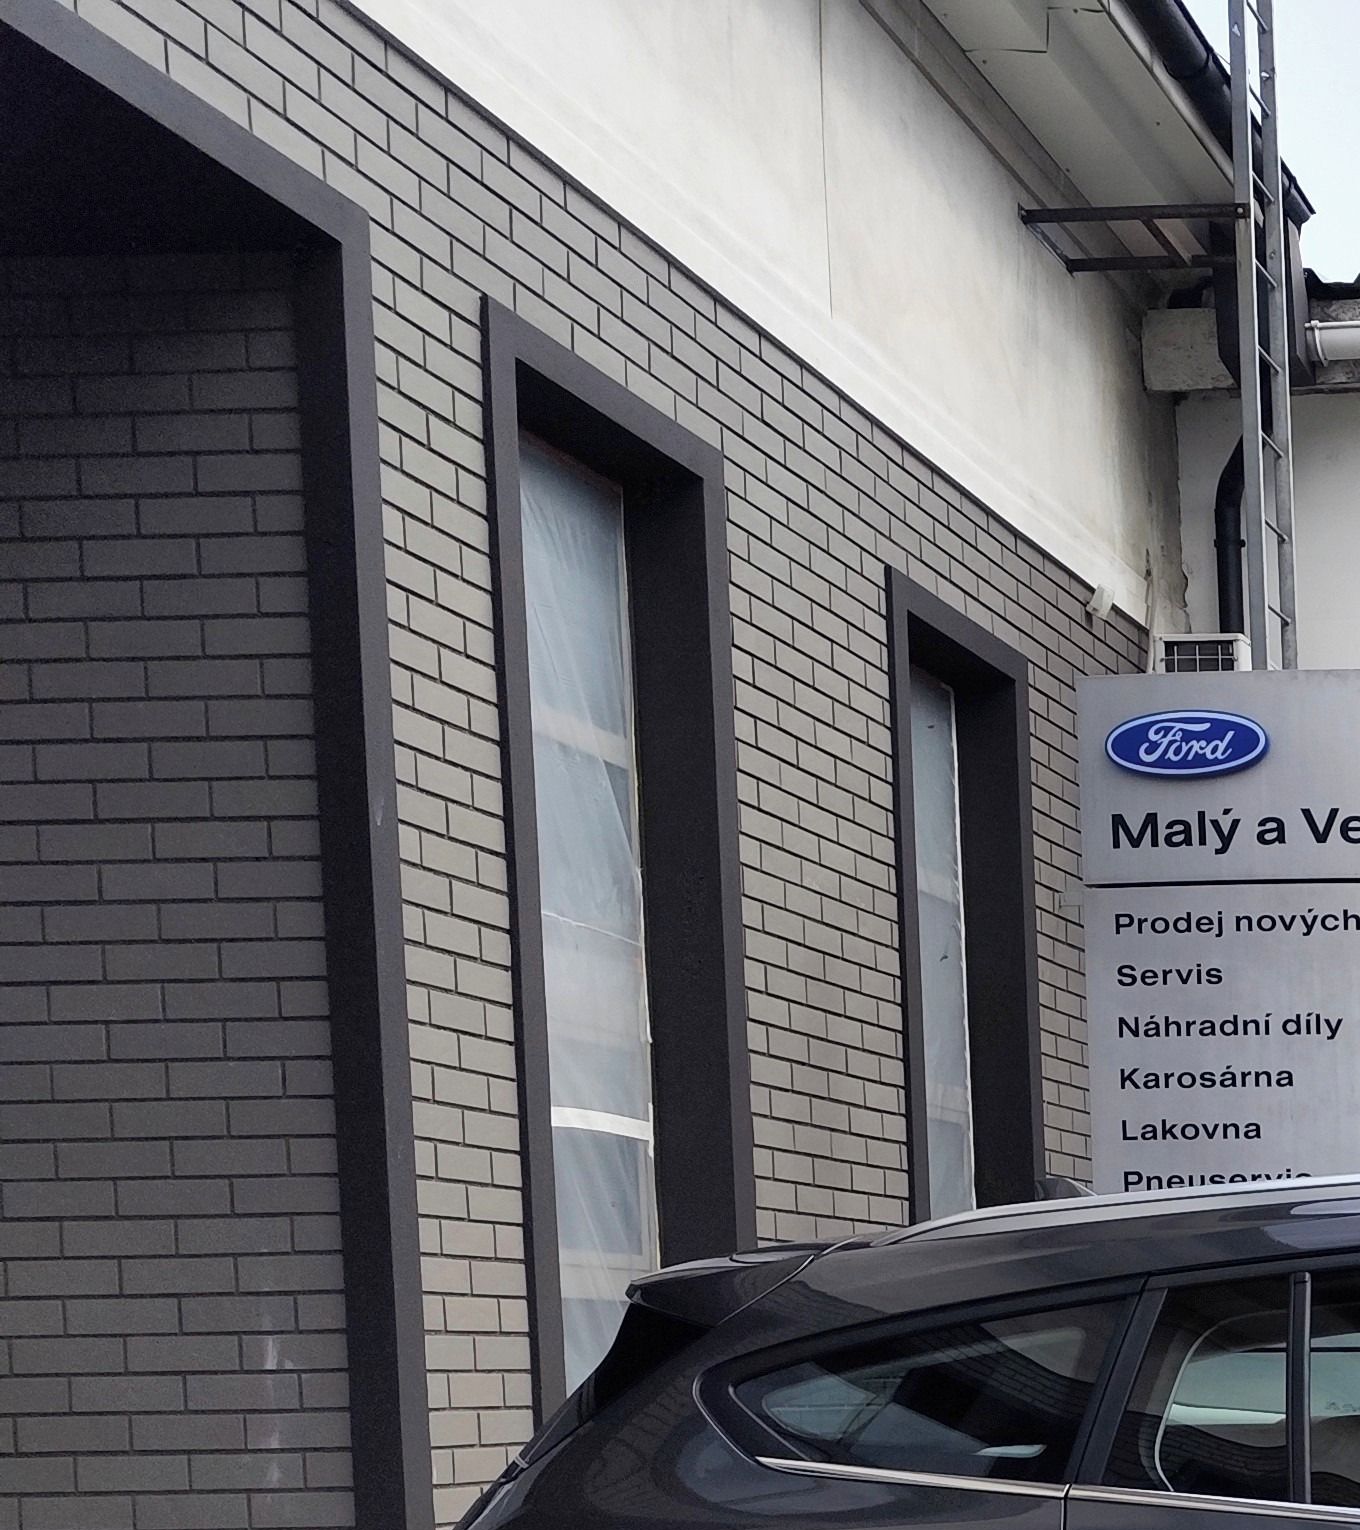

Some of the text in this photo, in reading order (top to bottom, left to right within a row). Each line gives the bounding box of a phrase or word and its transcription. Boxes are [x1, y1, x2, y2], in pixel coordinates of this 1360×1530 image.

[1138, 721, 1235, 763] Ford
[1110, 807, 1242, 856] Malý
[1256, 816, 1287, 846] a
[1114, 910, 1224, 938] Prodej
[1235, 908, 1360, 937] nových
[1116, 963, 1223, 987] Servis
[1118, 1012, 1344, 1041] Náhradní díly
[1119, 1064, 1294, 1090] Karosárna
[1121, 1118, 1262, 1141] Lakovna
[1123, 1168, 1312, 1193] Pneuse
